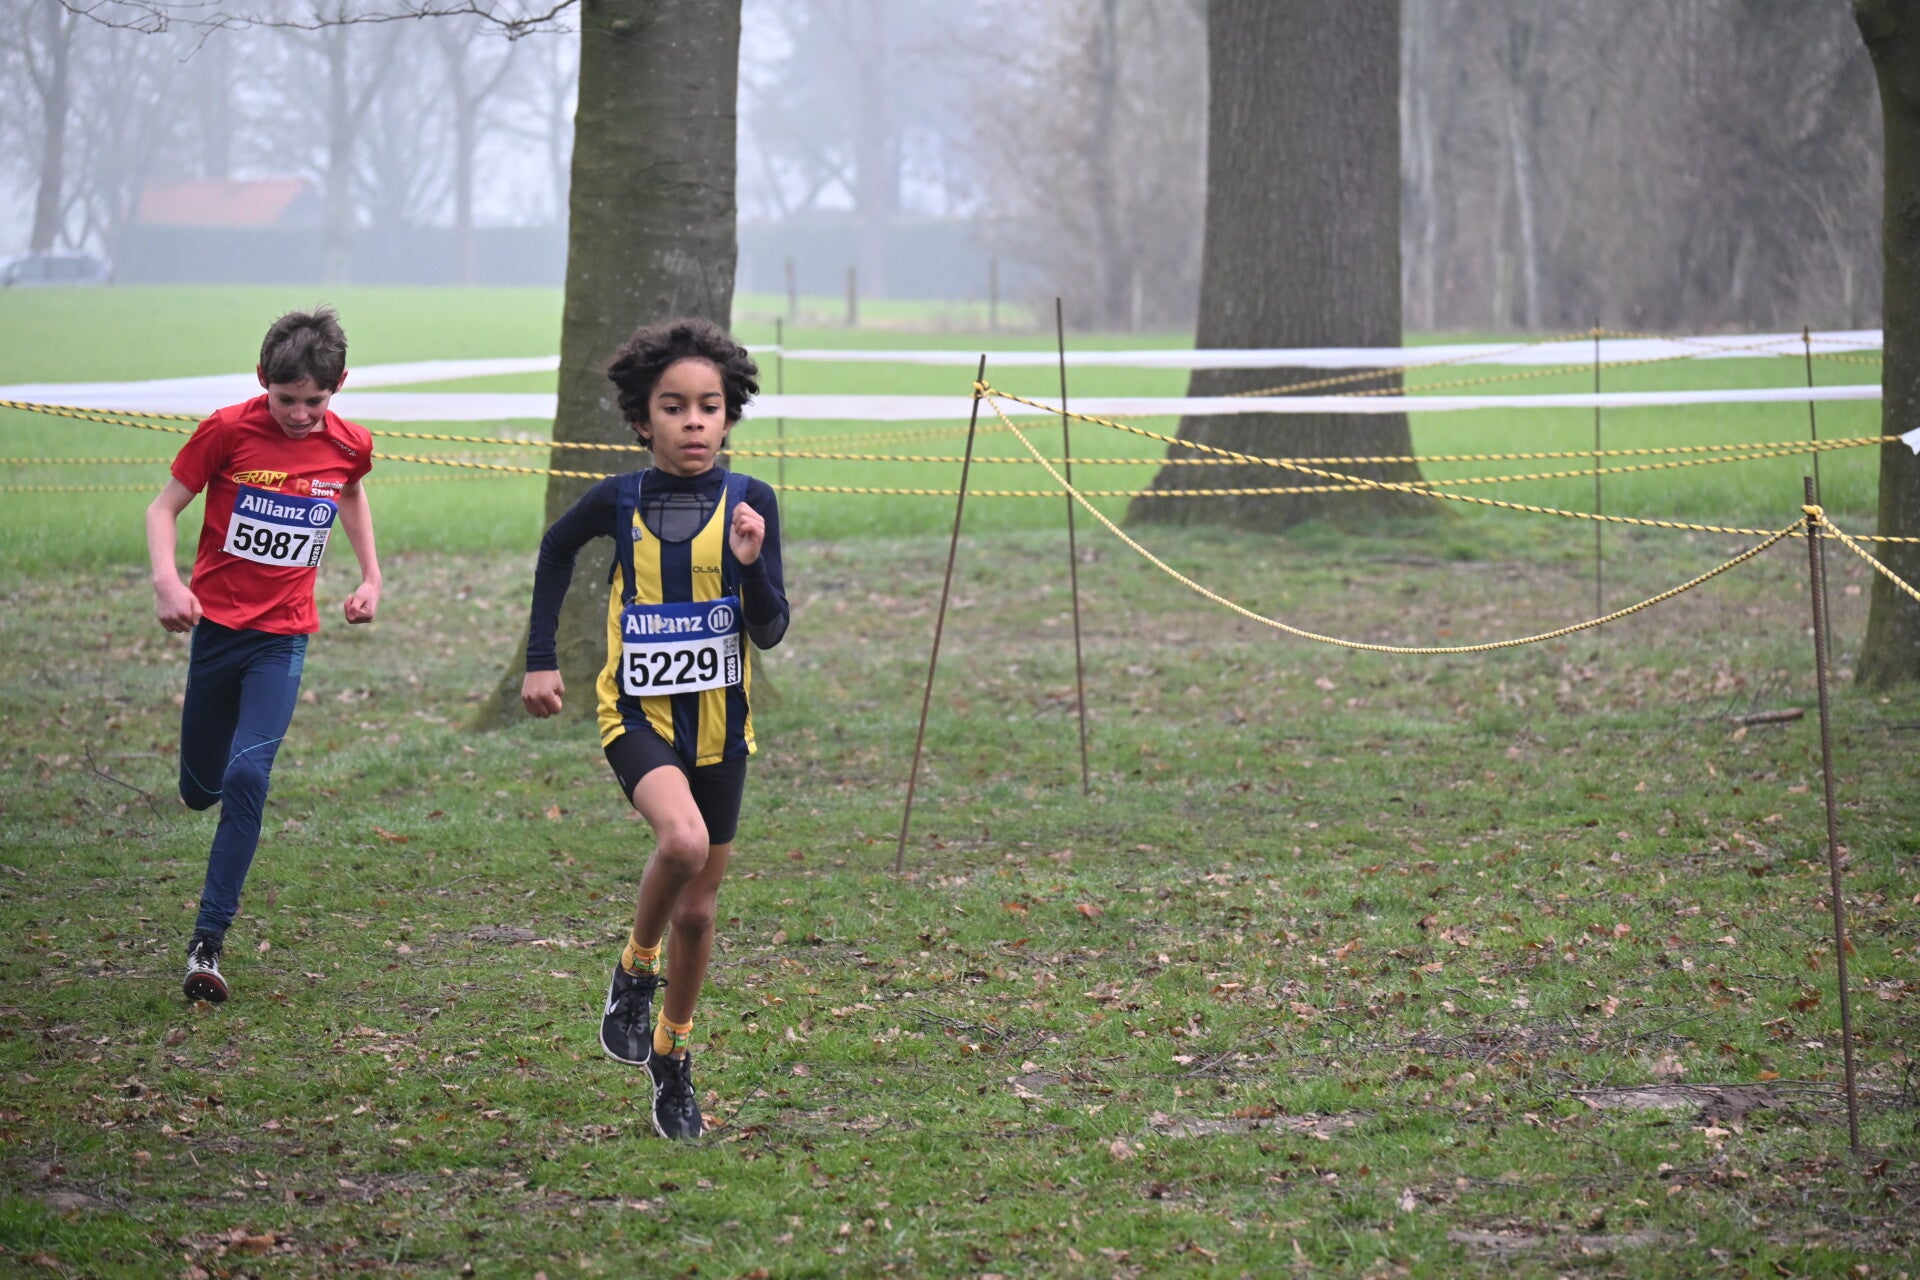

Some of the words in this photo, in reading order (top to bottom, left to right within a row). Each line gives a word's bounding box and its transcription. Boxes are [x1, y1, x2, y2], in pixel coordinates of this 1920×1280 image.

[240, 494, 306, 521] Allianz
[233, 522, 310, 561] 5987
[629, 647, 718, 687] 5229
[726, 656, 736, 683] 2026
